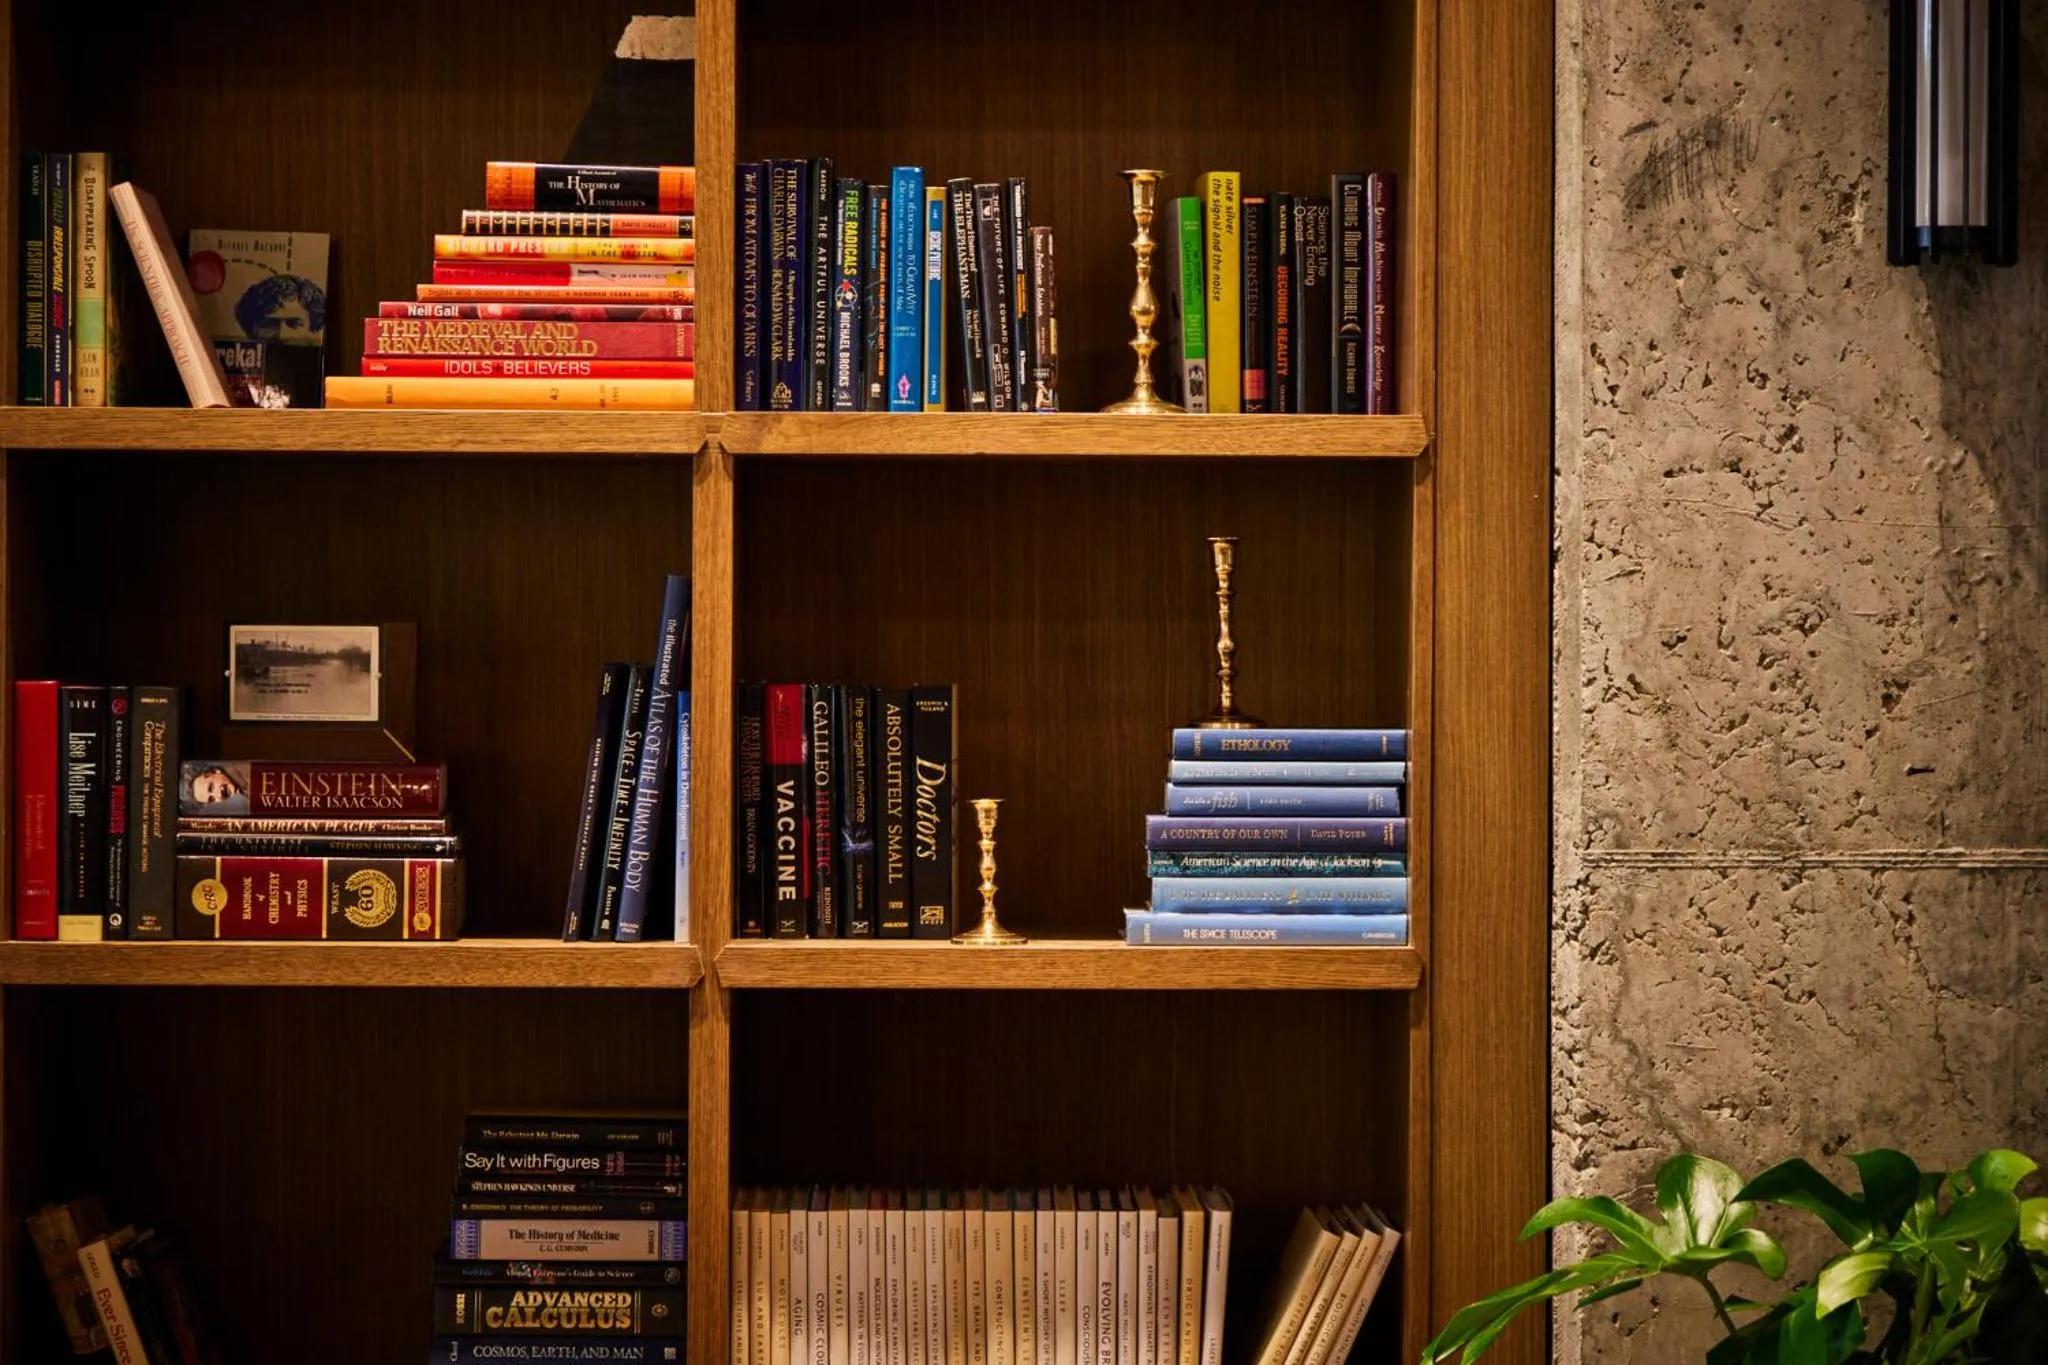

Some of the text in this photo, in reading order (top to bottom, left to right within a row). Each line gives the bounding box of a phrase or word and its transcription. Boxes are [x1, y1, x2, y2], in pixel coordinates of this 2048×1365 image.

[547, 175, 621, 191] THE HISTORY OF
[787, 169, 798, 194] THE
[1225, 177, 1236, 236] nate silver
[84, 177, 97, 290] DISAPPEARING SPOON
[773, 167, 785, 260] CHARLES DARWIN
[787, 195, 798, 244] SURVIVAL
[817, 215, 828, 239] THE
[843, 189, 858, 276] FREE RADICALS
[53, 225, 66, 293] IRRESPONSIBLE
[787, 245, 798, 260] OF
[954, 190, 971, 299] THE ELEPHANT MAN
[992, 193, 1005, 296] THE FUTURE OF LIFE
[1209, 177, 1224, 303] the signal and the noise
[1246, 205, 1259, 318] SIMPLY EINSTEIN
[1343, 183, 1363, 321] CLIMBING MOUNT IMPROBABLE
[742, 197, 757, 358] FROM ATOMS QUARKS
[816, 246, 828, 293] ARTFUL
[905, 265, 918, 315] CREATIVITY
[1318, 256, 1329, 277] the
[23, 239, 44, 350] DISRUPTED DIALOGUE
[407, 304, 459, 318] Neil Gall
[772, 269, 784, 361] RONALD CLARK
[1276, 265, 1290, 324] DECODING
[378, 321, 578, 341] THE MEDIEVAL AND
[378, 338, 599, 357] RENAISSANCE WORLD
[815, 301, 828, 366] UNIVERSE
[838, 312, 851, 387] MICHAEL BROOKS
[999, 303, 1012, 401] EDWARD WILSON
[1276, 327, 1290, 376] REALITY
[443, 360, 591, 376] IDOLS BELIEVERS
[113, 719, 123, 783] ENGINEERING
[624, 633, 676, 895] illustrated ATLAS OF THE HUMAN BODY
[852, 697, 867, 824] the elegant universe
[1220, 738, 1293, 752] ETHOLOGY
[67, 731, 97, 818] Lise Meitner
[150, 721, 167, 839] The Electrical Equipment
[260, 770, 405, 798] EINSTEIN
[811, 700, 831, 877] GALILEO HERETIC
[886, 702, 904, 885] ABSOLUTELY SMALL
[260, 795, 404, 810] WALTER ISAACSON
[605, 729, 643, 871] SPACE TIME INFINITY
[915, 754, 948, 862] Doctors
[249, 820, 378, 833] AMERICAN PLAGUE
[776, 779, 797, 902] VACCINE
[1160, 829, 1289, 841] A COUNTRY OF OUR OWN
[1180, 855, 1230, 868] American
[1231, 855, 1270, 868] Science
[1299, 856, 1319, 870] Age
[241, 875, 253, 921] HANDBOOK
[268, 871, 281, 925] CHEMISTRY
[296, 878, 309, 919] PHYSICS
[356, 884, 374, 911] 60
[1182, 928, 1278, 941] THE SPACE TELESCOPE
[464, 1152, 601, 1172] Say It with Figures
[508, 1229, 621, 1244] The History of Medicine
[96, 1287, 119, 1324] Ever
[485, 1306, 633, 1330] CALCULUS
[510, 1290, 633, 1309] ADVANCED
[756, 1306, 765, 1329] AND
[792, 1297, 804, 1337] AGING
[814, 1292, 826, 1334] COSMIC
[834, 1273, 844, 1328] VIRUSES
[994, 1279, 1005, 1355] CONSTRUCTING
[1021, 1276, 1032, 1344] EINSTEIN'S
[1042, 1279, 1051, 1341] SHORT HISTORY
[1101, 1280, 1113, 1344] EVOLVING
[472, 1344, 644, 1362] COSMOS, EARTH, AND MAN
[974, 1342, 982, 1363] AND
[1183, 1321, 1193, 1346] AND
